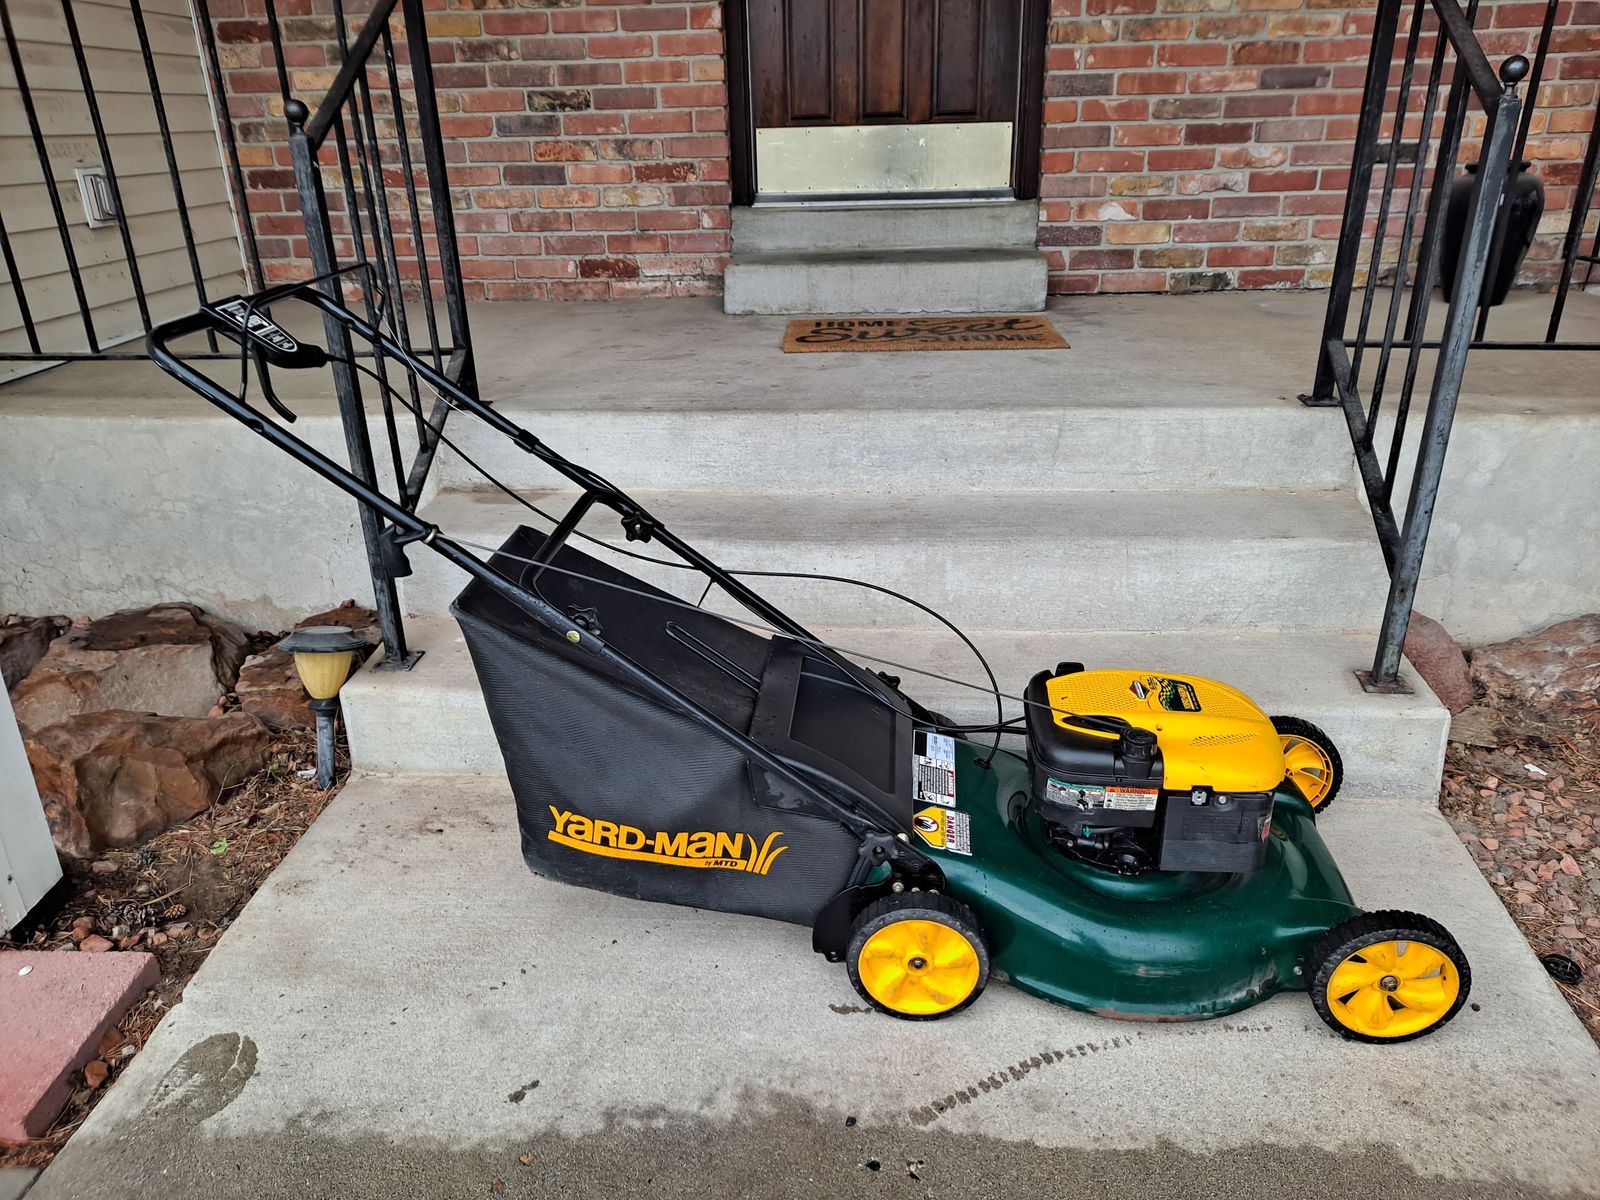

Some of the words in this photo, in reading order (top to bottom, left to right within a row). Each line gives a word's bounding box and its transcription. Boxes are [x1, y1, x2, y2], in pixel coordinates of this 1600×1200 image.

[814, 320, 902, 328] HOME
[796, 318, 1045, 343] Sweet
[948, 333, 1045, 342] HOME
[946, 815, 955, 844] DANGER
[713, 859, 738, 867] MTD
